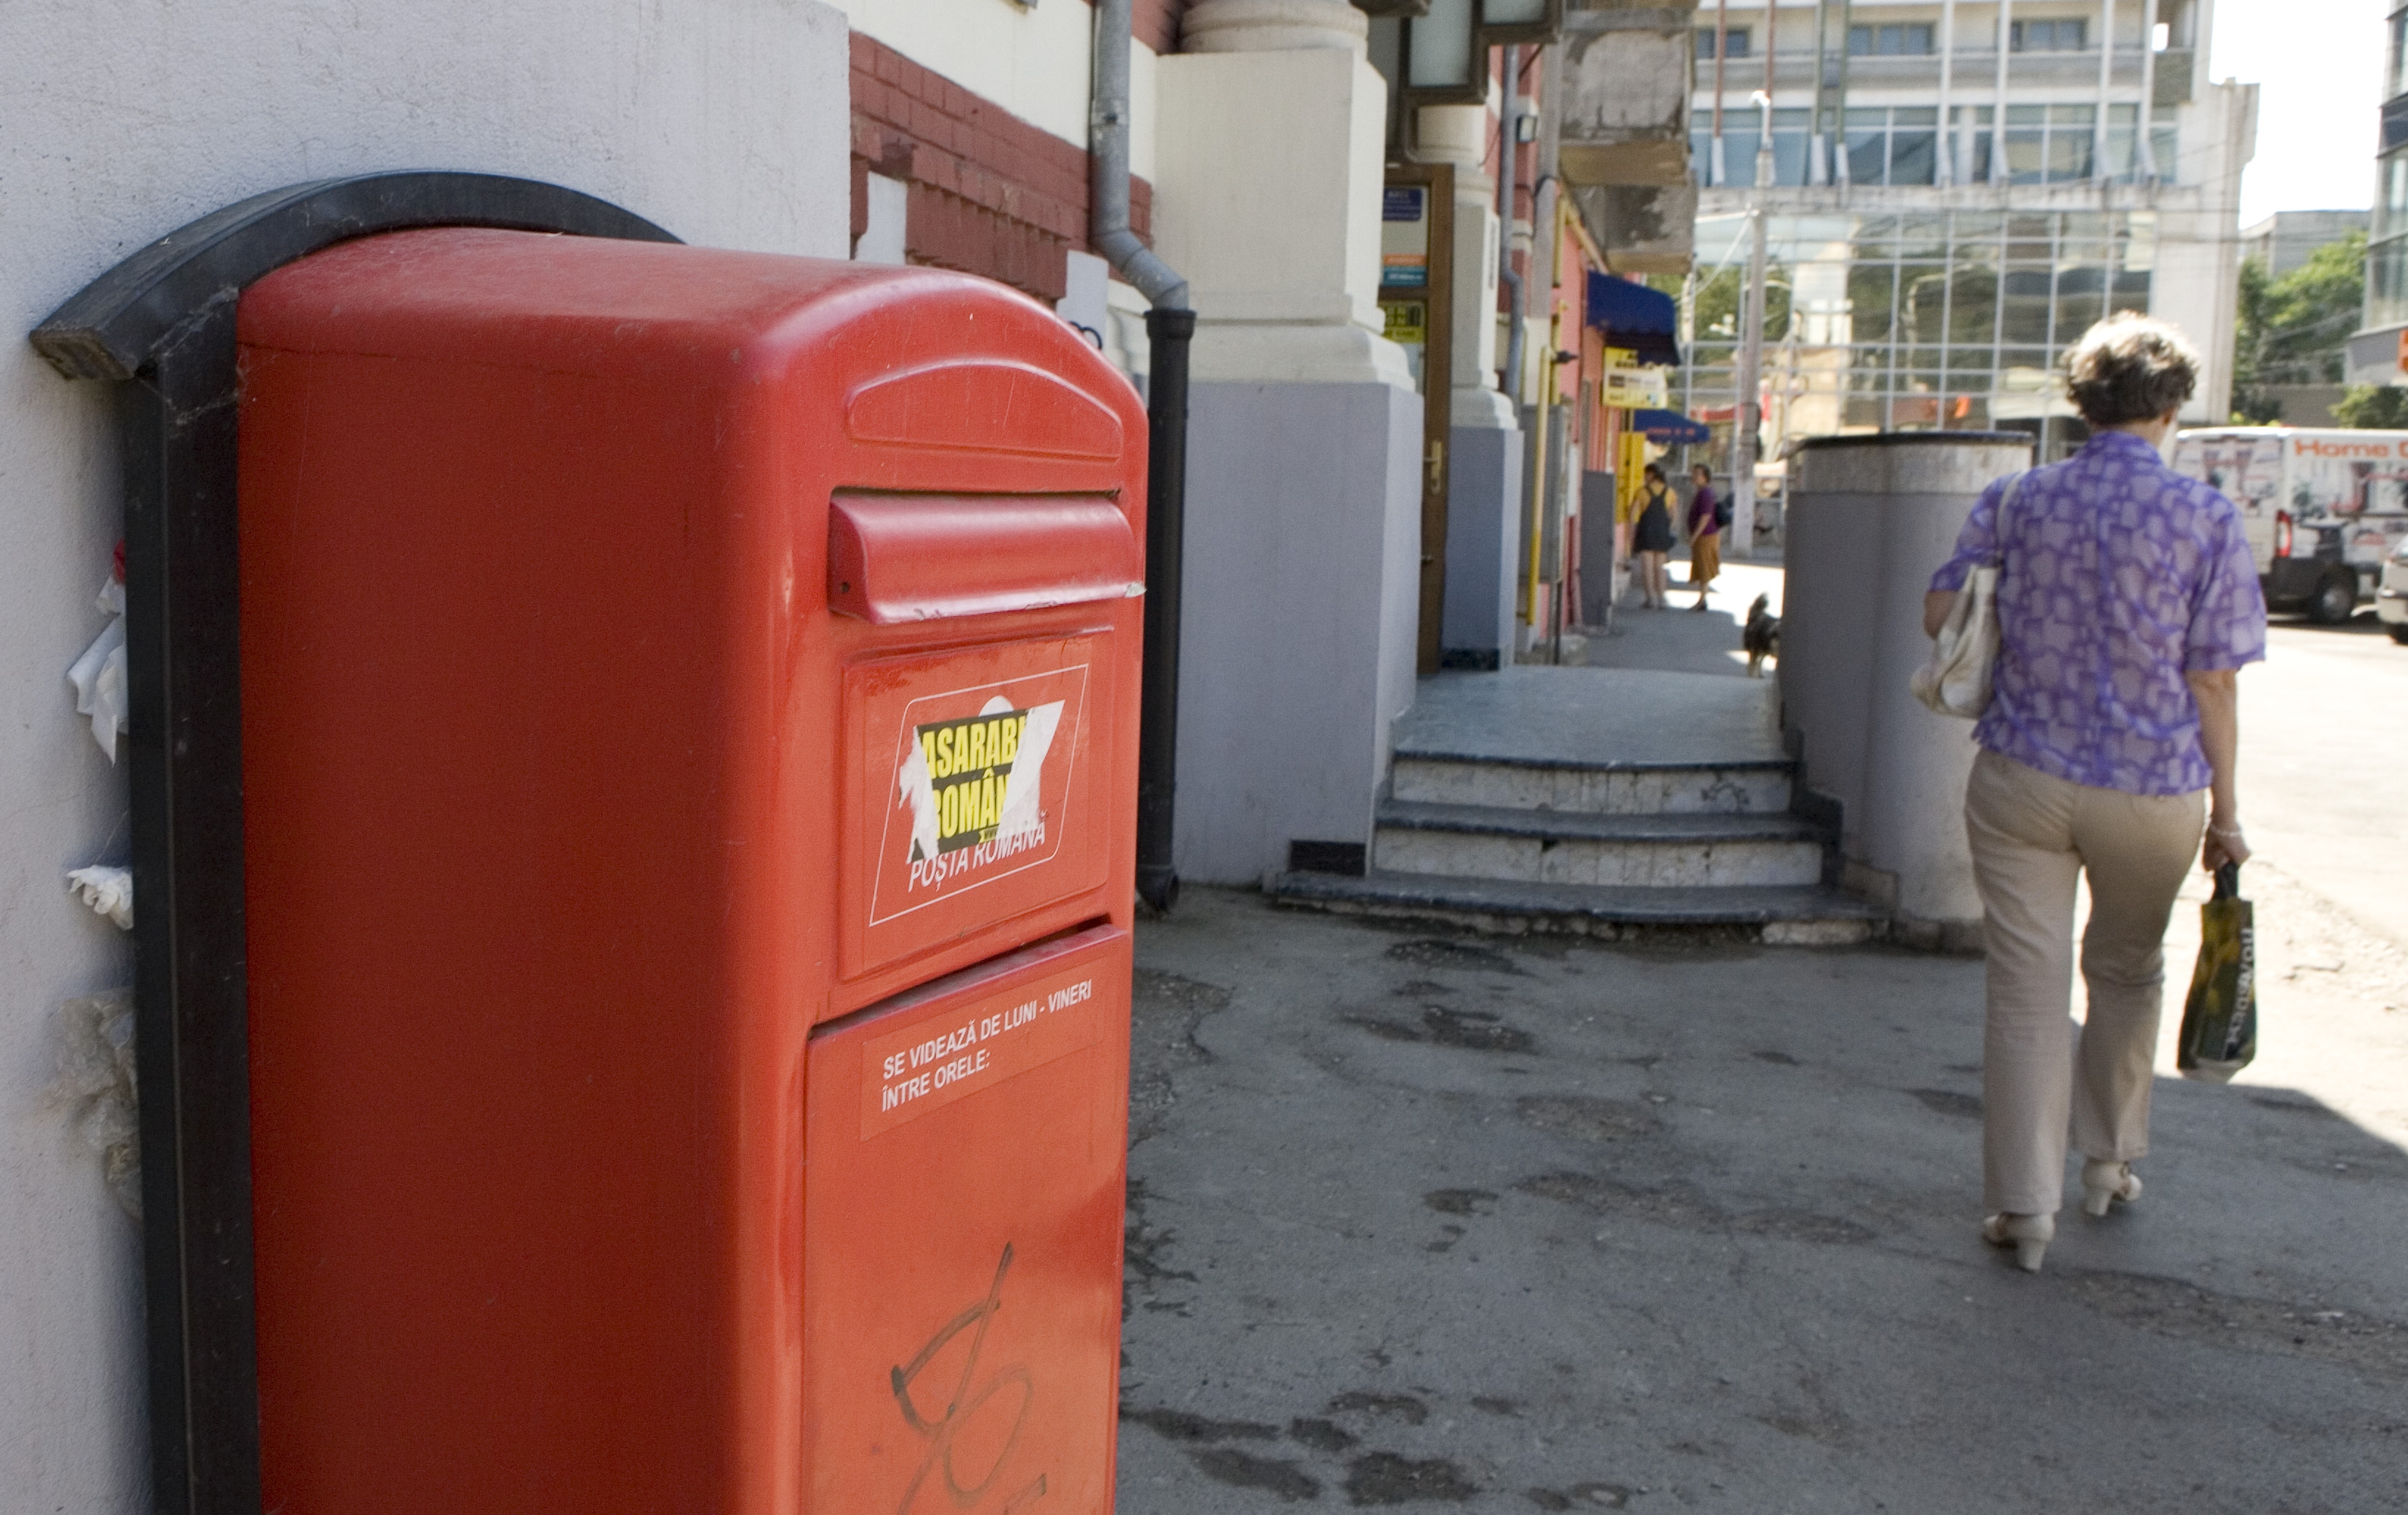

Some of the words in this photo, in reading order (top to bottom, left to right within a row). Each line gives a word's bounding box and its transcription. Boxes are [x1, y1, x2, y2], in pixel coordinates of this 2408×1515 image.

[2294, 438, 2389, 458] Home
[883, 1050, 906, 1081] SE
[909, 1019, 977, 1070] VIDEAZĂ
[980, 1013, 1001, 1041] DE
[1003, 999, 1037, 1031] LUNI
[1048, 978, 1092, 1014] VINERI
[882, 1070, 931, 1112] ÎNTRE
[934, 1048, 991, 1089] ORELE:
